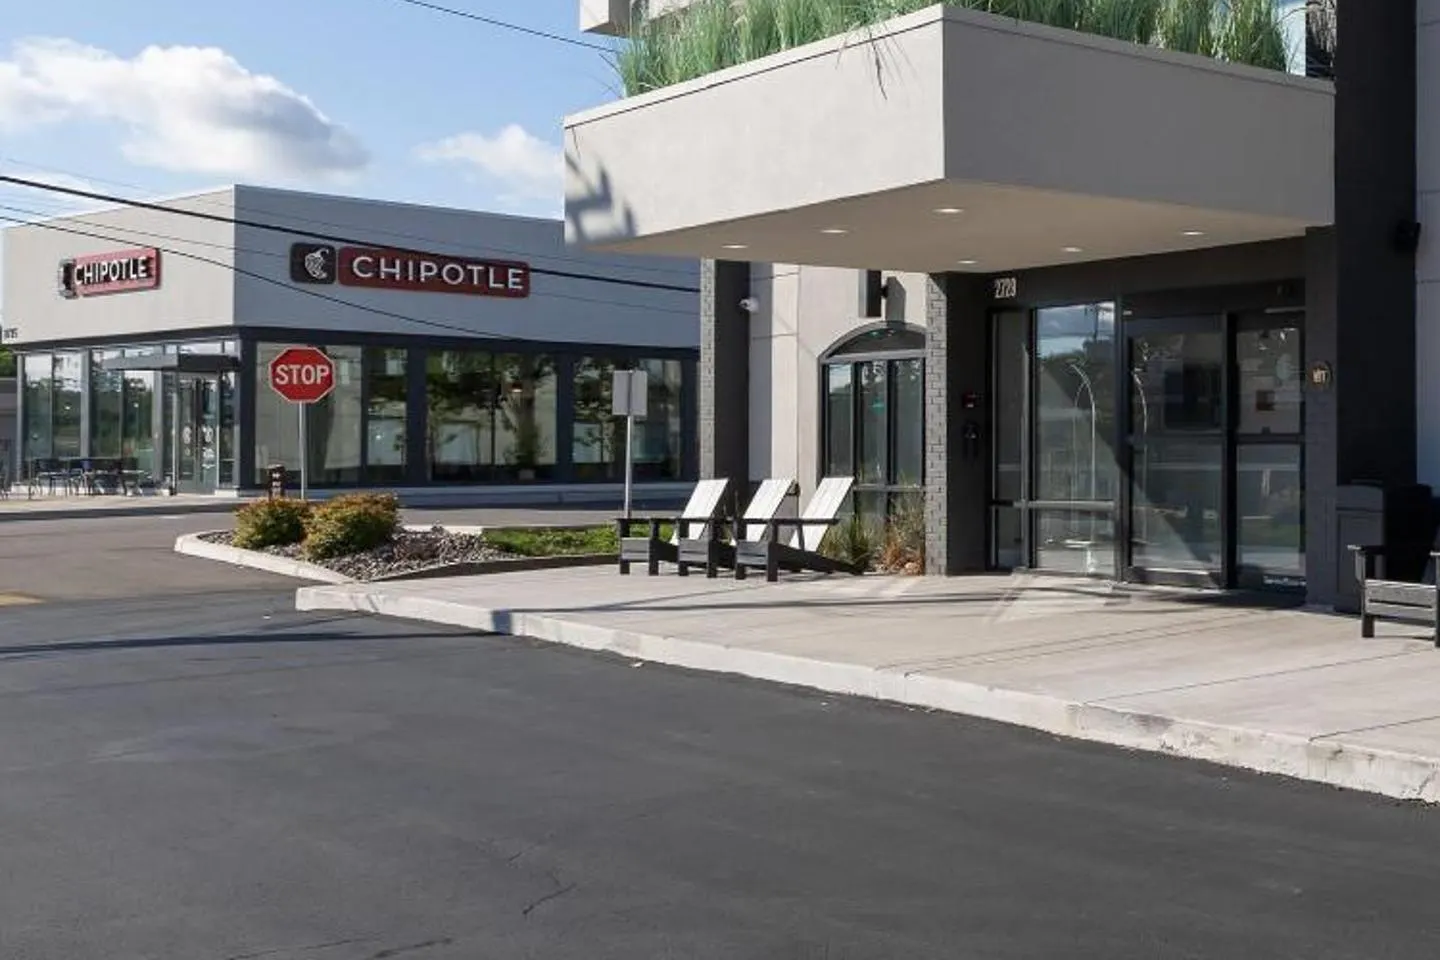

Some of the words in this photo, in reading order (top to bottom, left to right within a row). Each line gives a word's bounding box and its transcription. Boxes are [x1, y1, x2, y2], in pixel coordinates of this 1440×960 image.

[74, 256, 149, 285] CHIPOTLE
[352, 256, 524, 290] CHIPOTLE
[275, 364, 329, 385] STOP
